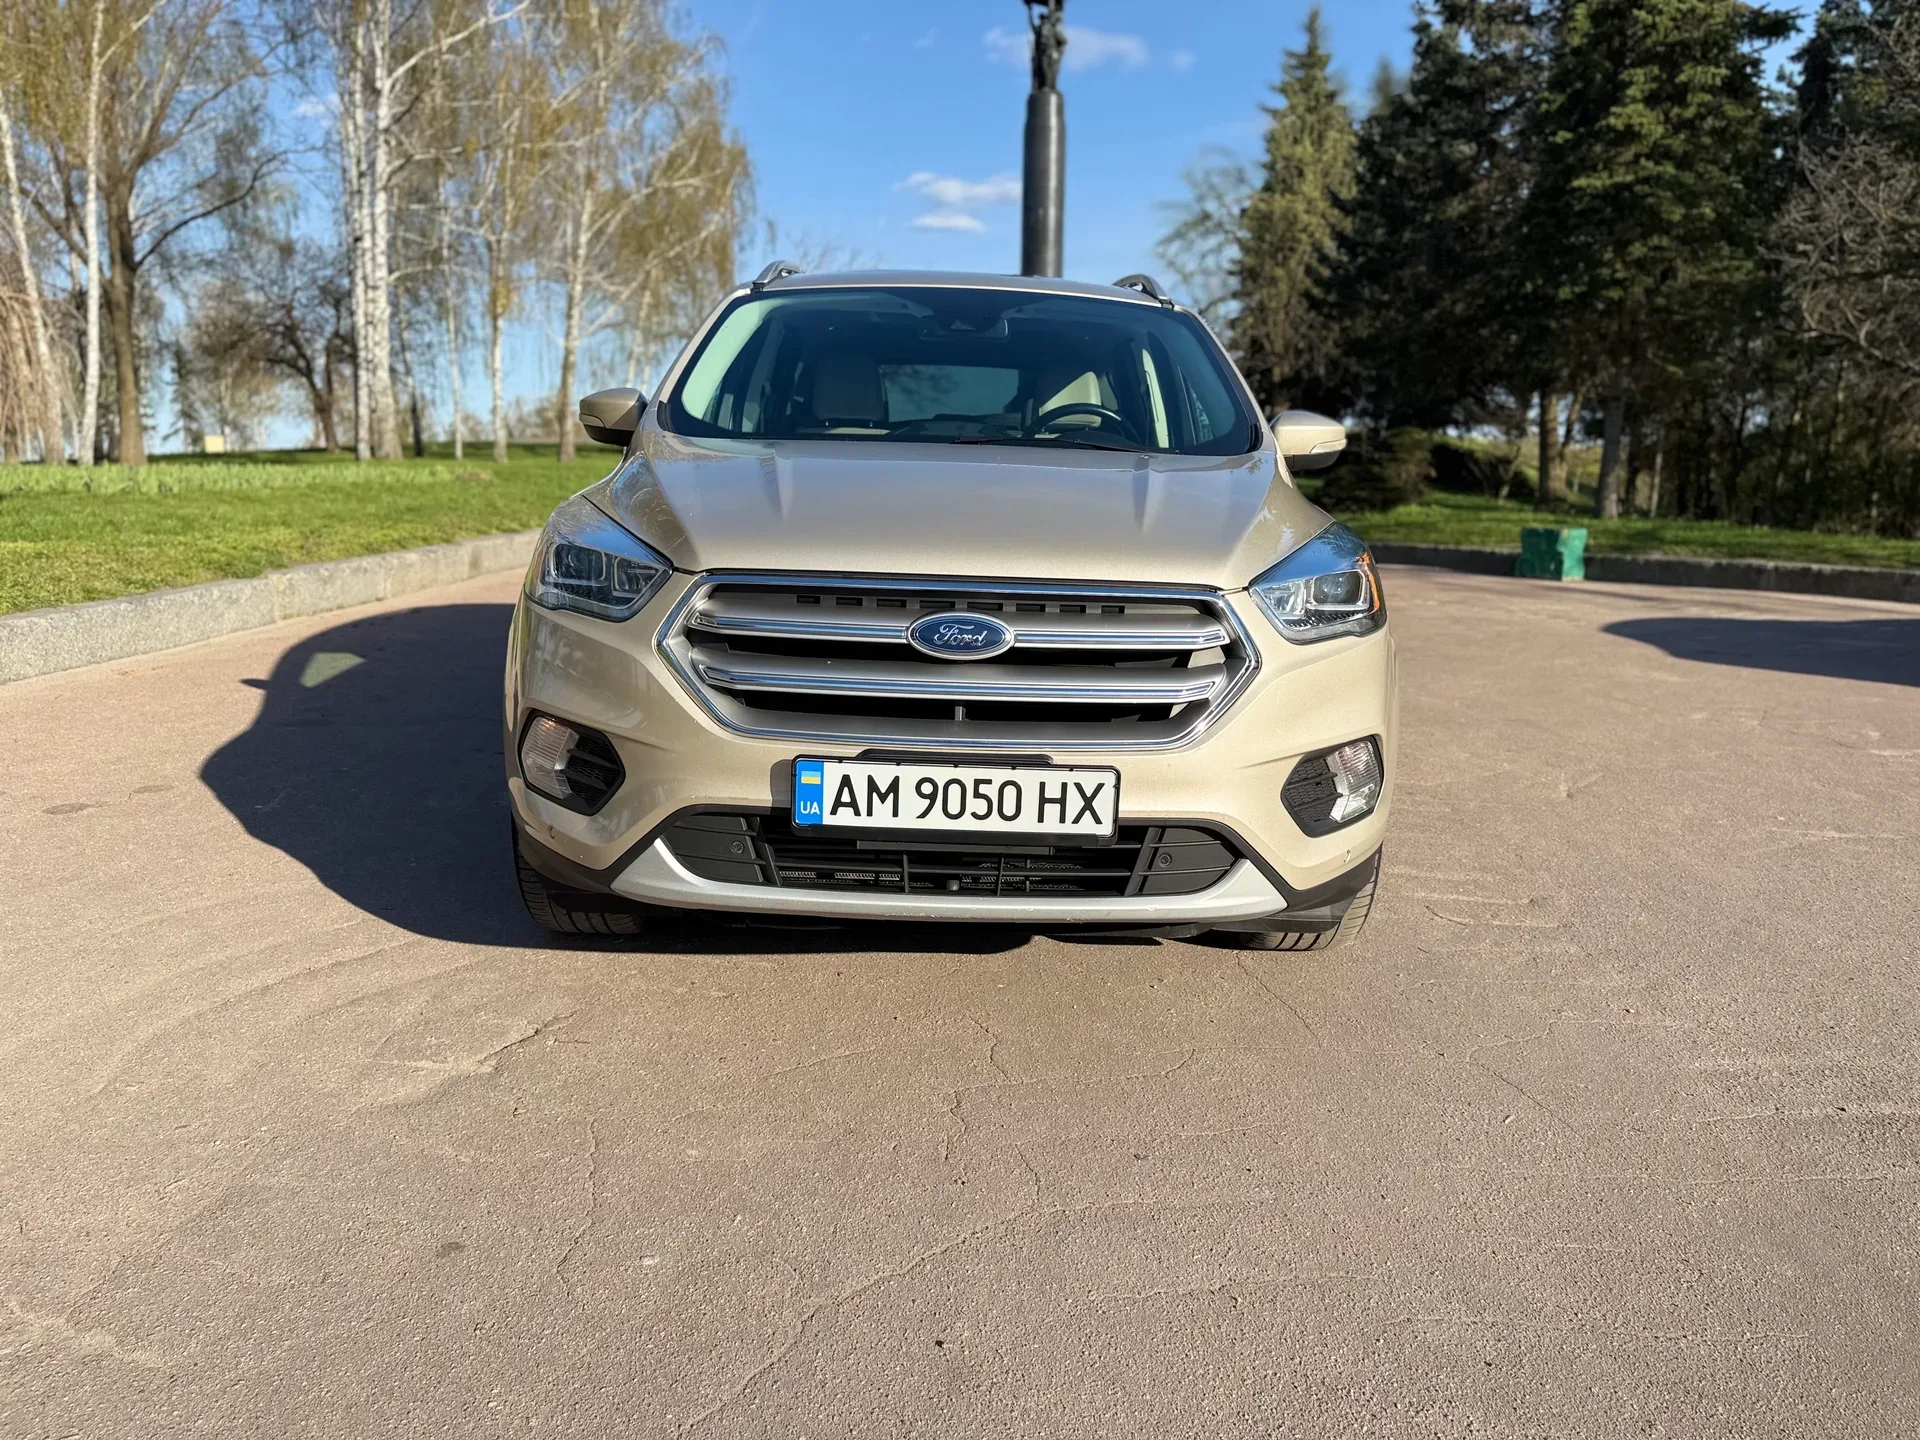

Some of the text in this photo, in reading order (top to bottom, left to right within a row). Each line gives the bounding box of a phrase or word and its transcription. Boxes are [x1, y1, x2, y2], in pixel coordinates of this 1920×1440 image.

[933, 623, 988, 646] Ford
[800, 800, 820, 815] UA
[829, 773, 1106, 825] AM 9050 HX
